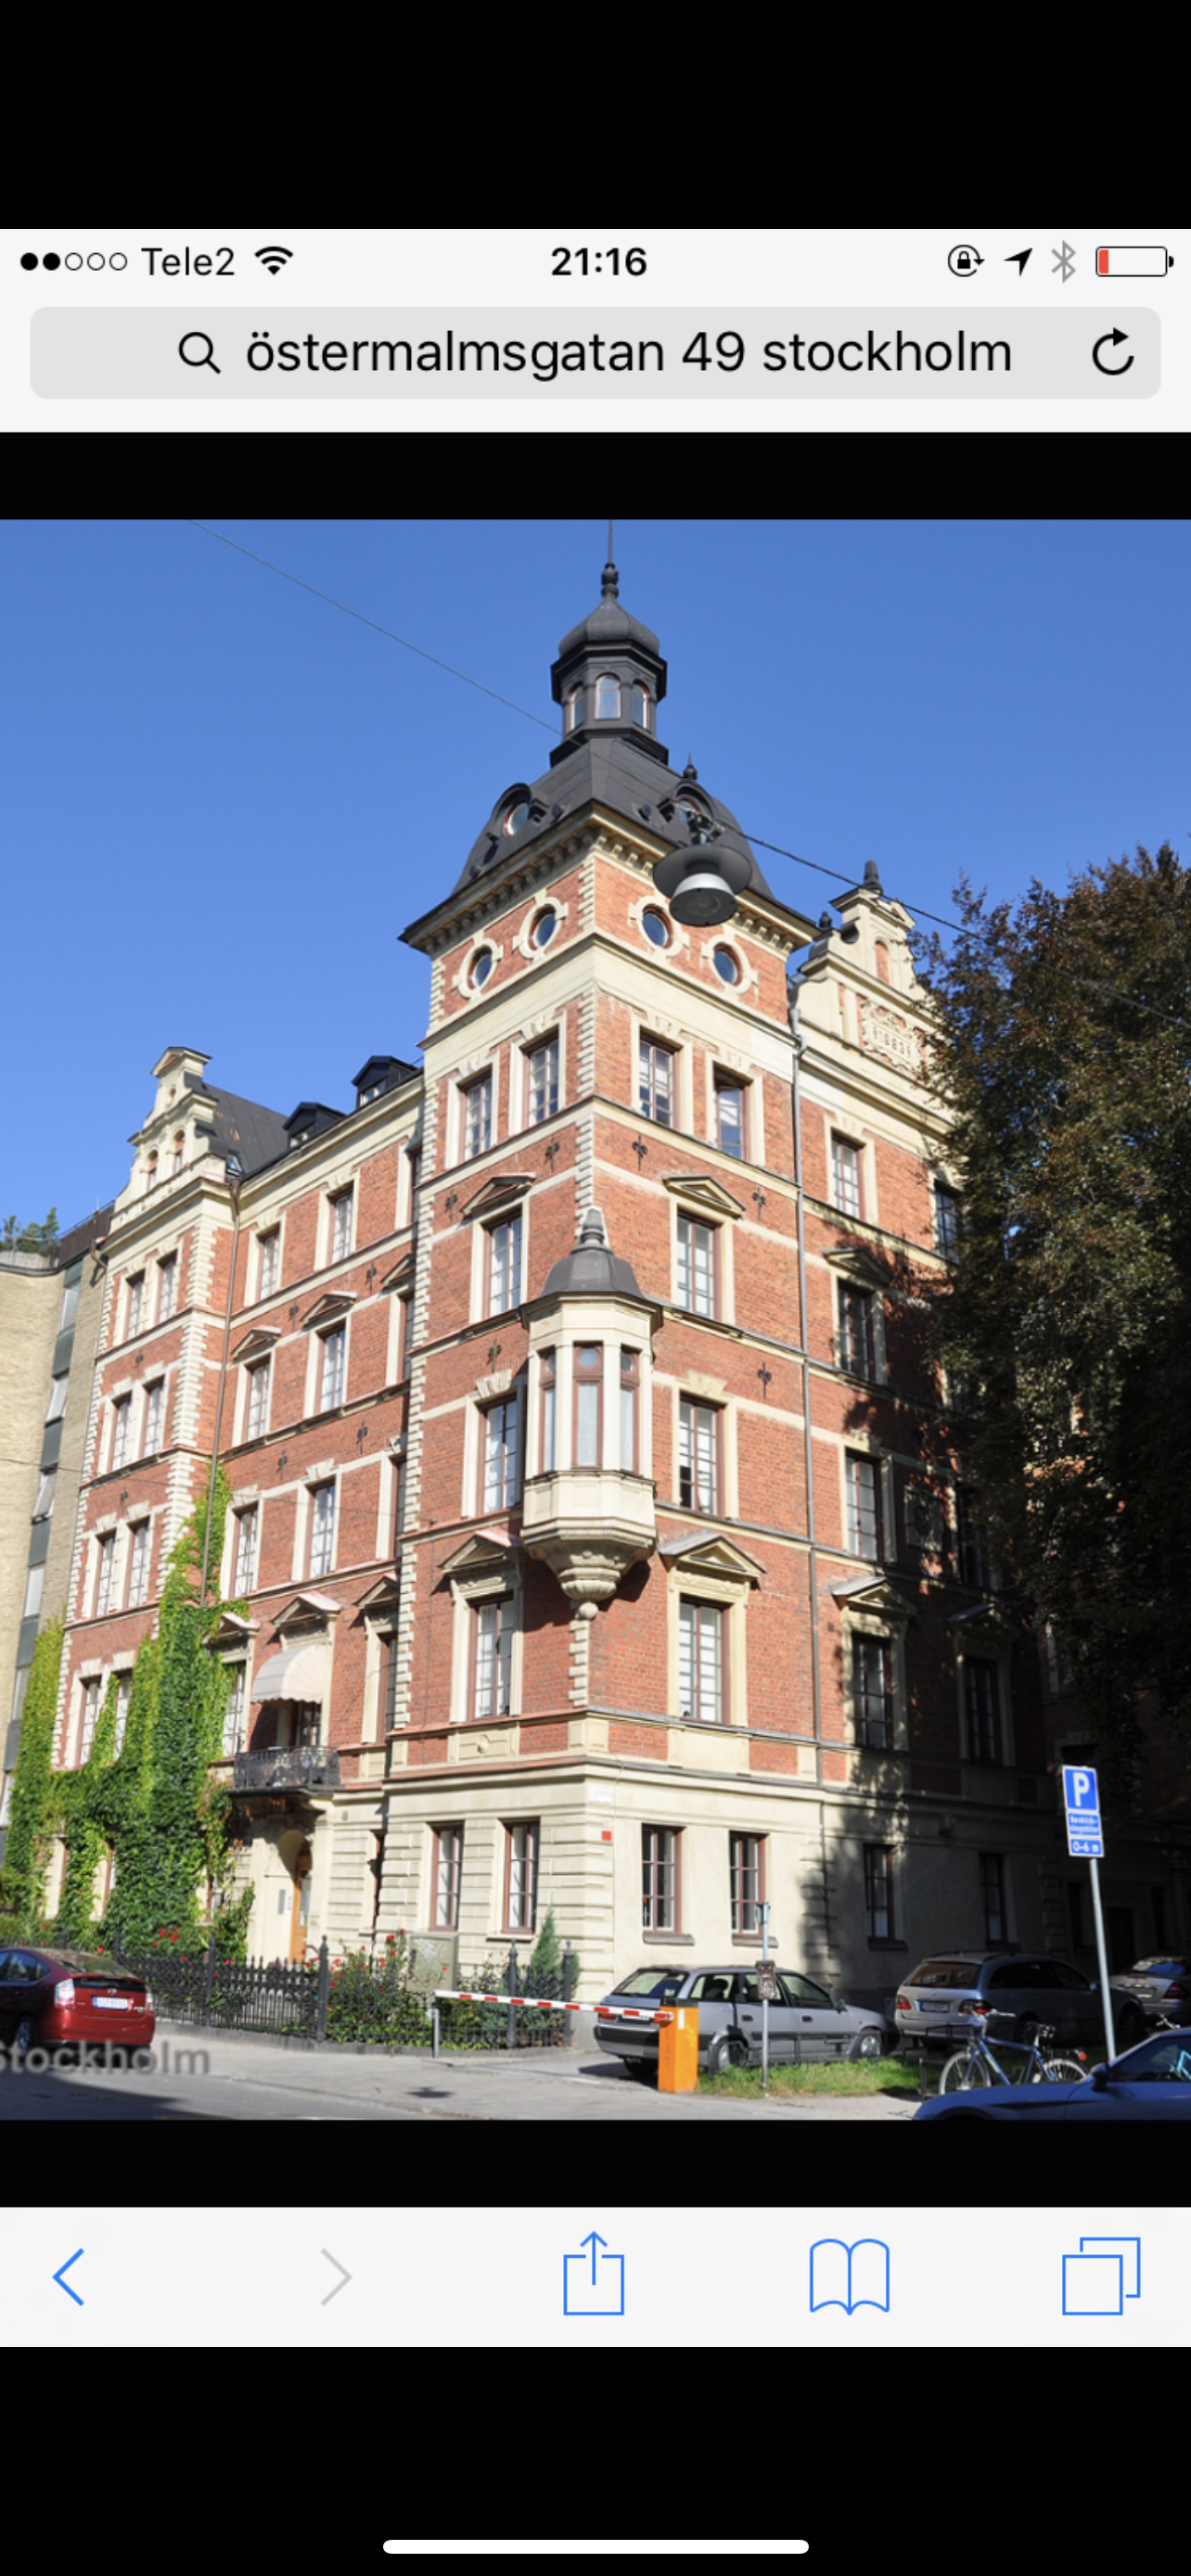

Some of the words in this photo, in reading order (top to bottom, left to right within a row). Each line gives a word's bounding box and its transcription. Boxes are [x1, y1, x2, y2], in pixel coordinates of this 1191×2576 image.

[140, 247, 236, 276] Tele2
[551, 247, 647, 276] 21:16
[247, 329, 664, 383] östermalmsgatan
[682, 330, 746, 373] 49
[762, 329, 1011, 372] stockholm
[1072, 1772, 1090, 1807] P
